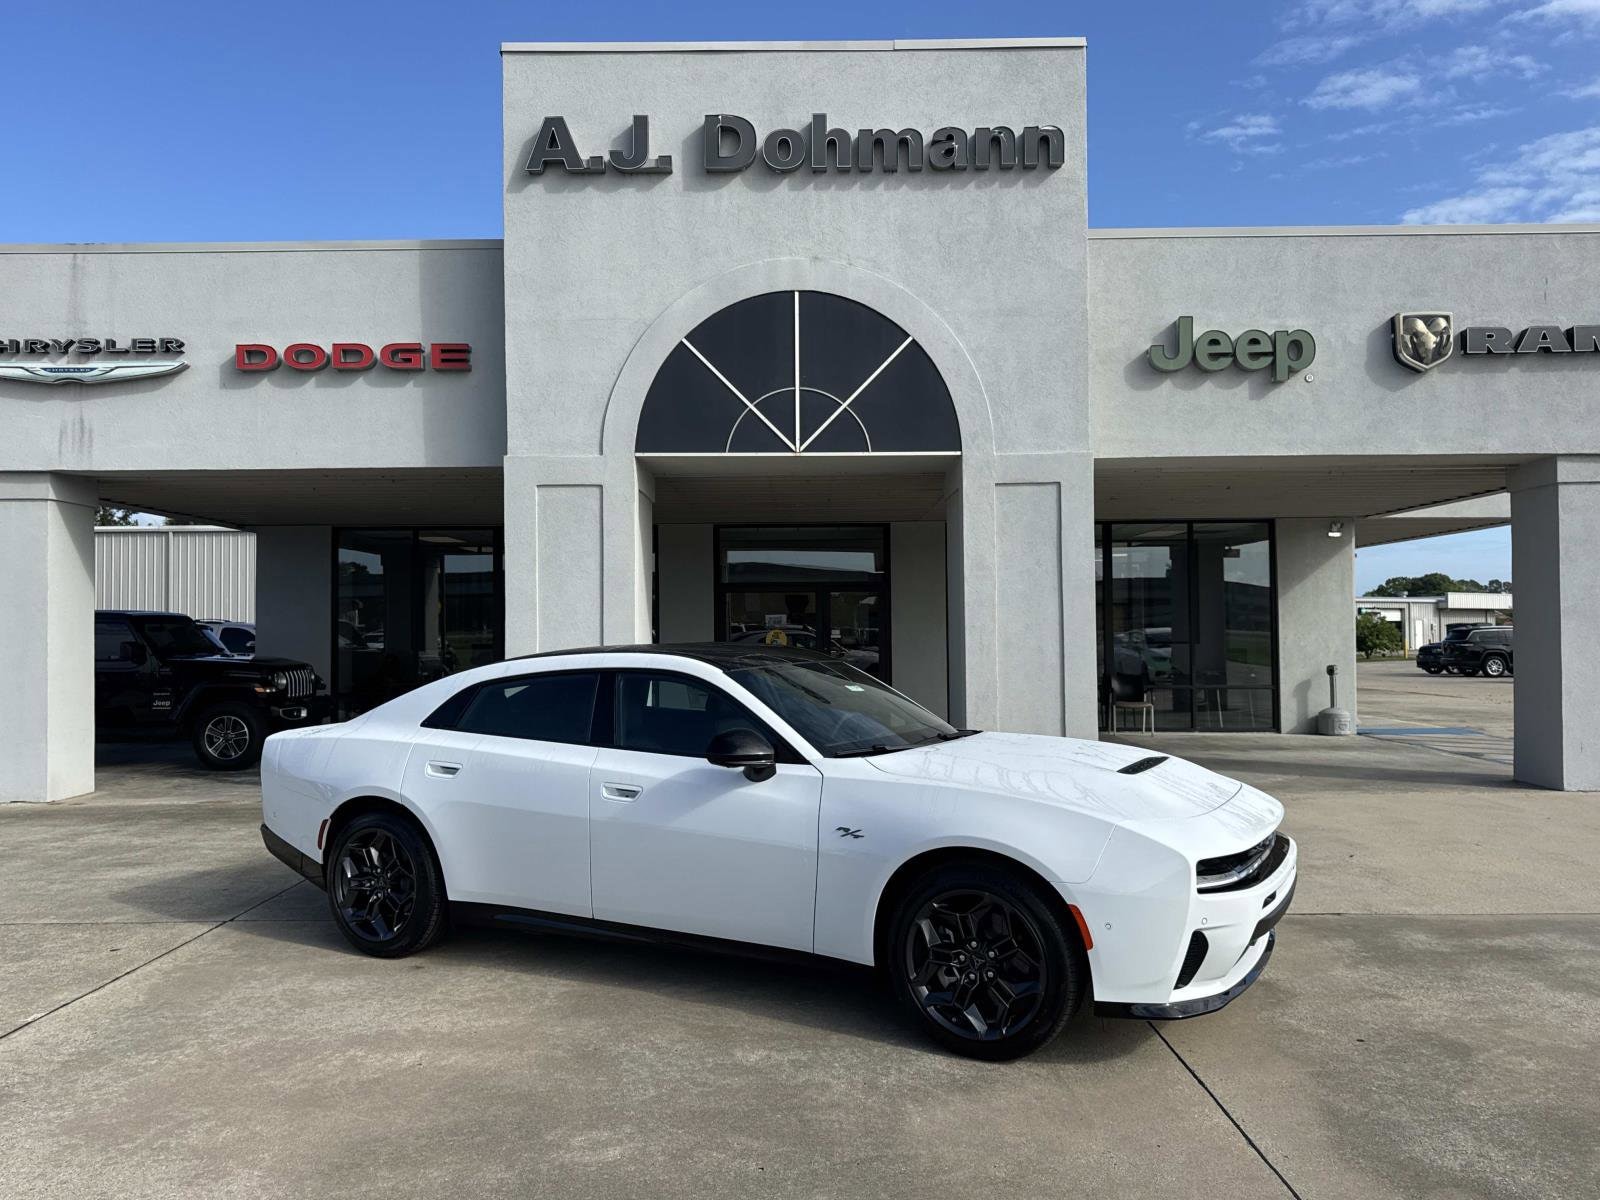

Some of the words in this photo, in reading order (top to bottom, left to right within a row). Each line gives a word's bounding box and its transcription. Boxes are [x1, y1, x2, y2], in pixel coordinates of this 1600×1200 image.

[524, 114, 673, 174] A.J.
[703, 113, 1065, 174] Dohmann
[235, 343, 471, 372] DODGE
[1149, 316, 1316, 382] Jeep
[152, 699, 171, 707] Jeep
